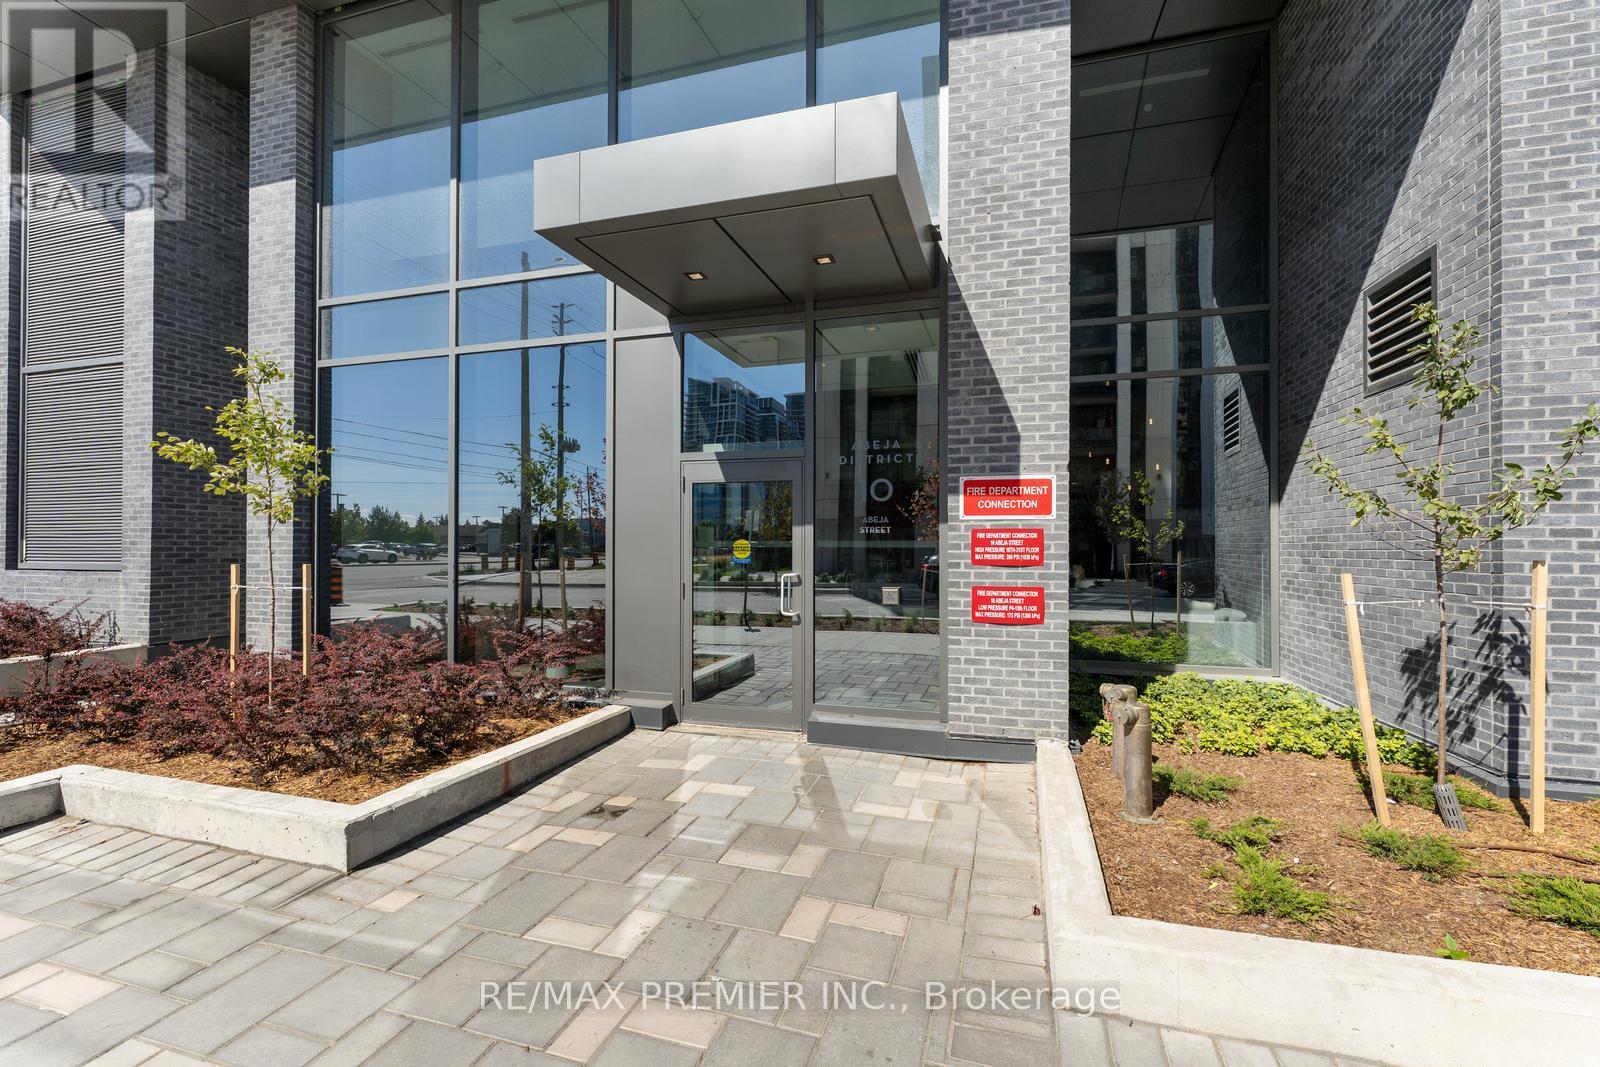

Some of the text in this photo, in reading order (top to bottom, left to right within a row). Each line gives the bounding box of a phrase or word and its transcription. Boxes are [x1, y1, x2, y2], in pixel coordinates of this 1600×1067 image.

[839, 453, 914, 465] DITRICT
[967, 486, 1048, 496] FIRE DEPARTMENT
[978, 500, 1038, 508] CONNECTION
[862, 516, 889, 524] ABEJA
[859, 526, 892, 534] STREET
